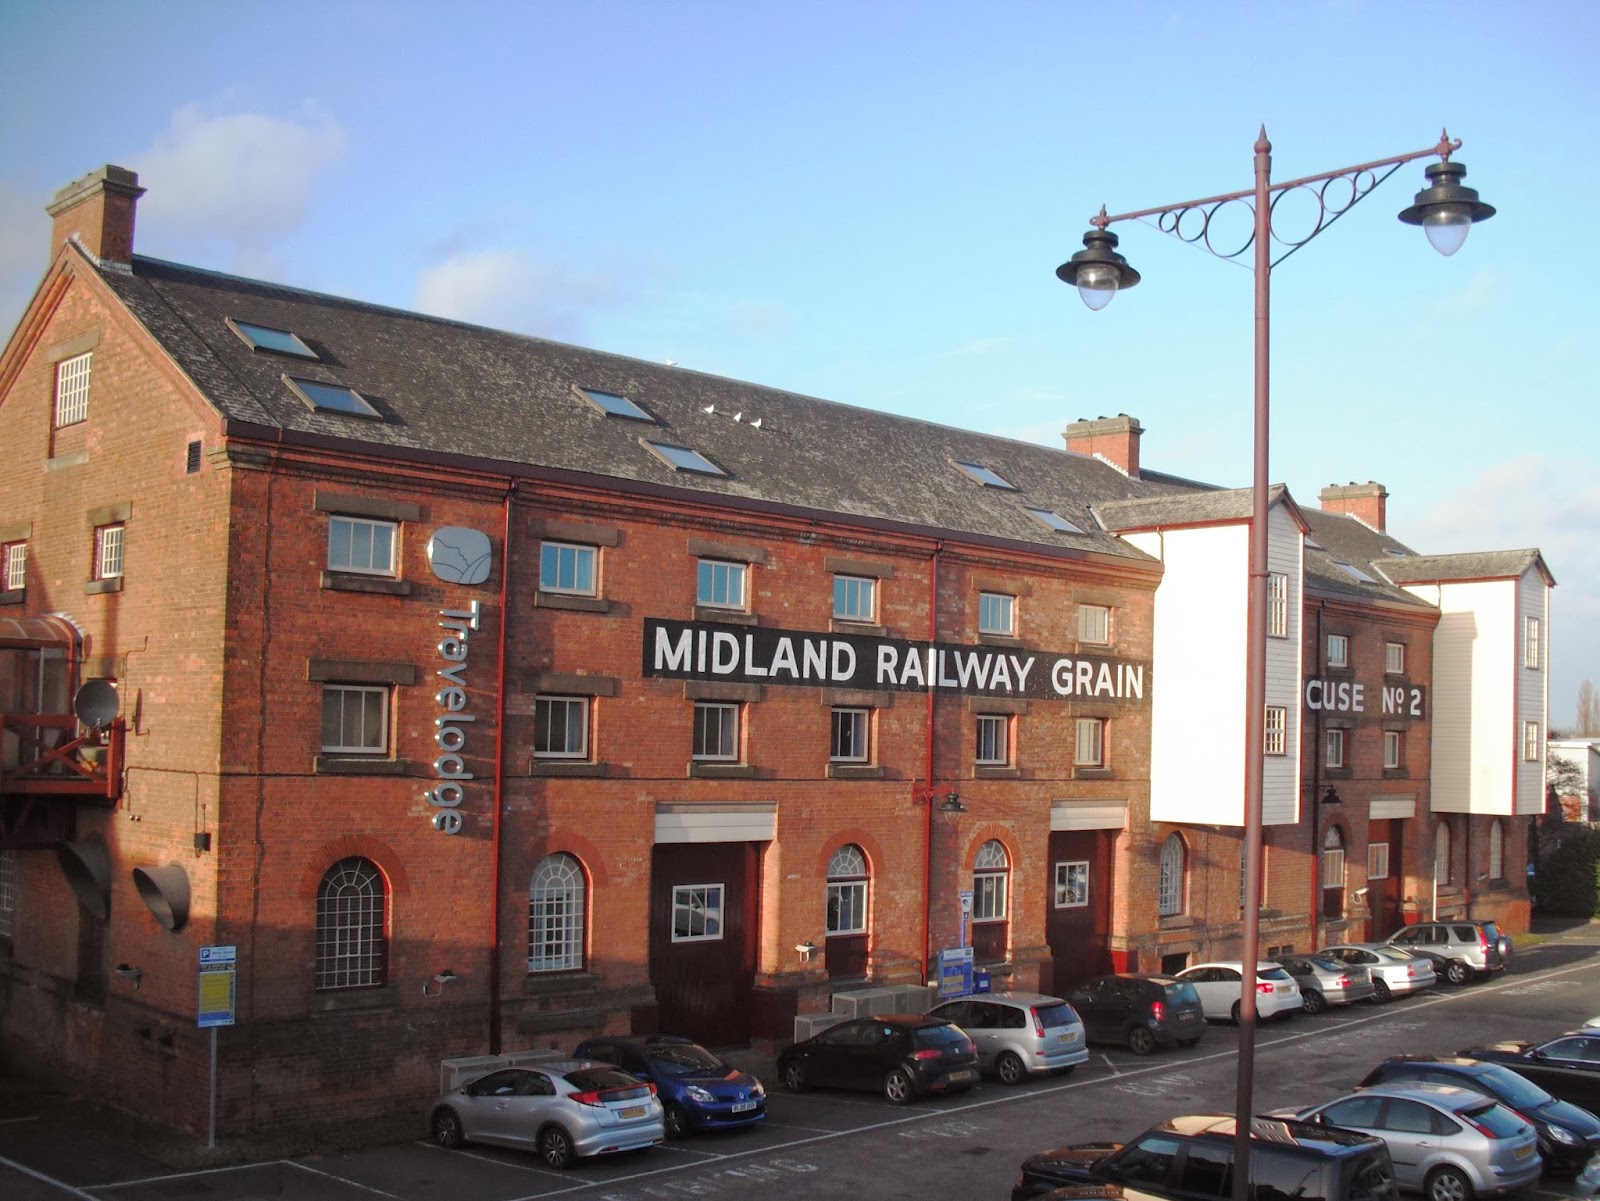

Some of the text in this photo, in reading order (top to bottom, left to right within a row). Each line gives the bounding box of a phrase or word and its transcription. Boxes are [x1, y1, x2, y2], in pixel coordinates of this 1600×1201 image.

[424, 600, 480, 836] Travelodge
[653, 626, 1144, 699] MIDLAND RAILWAY GRAIN
